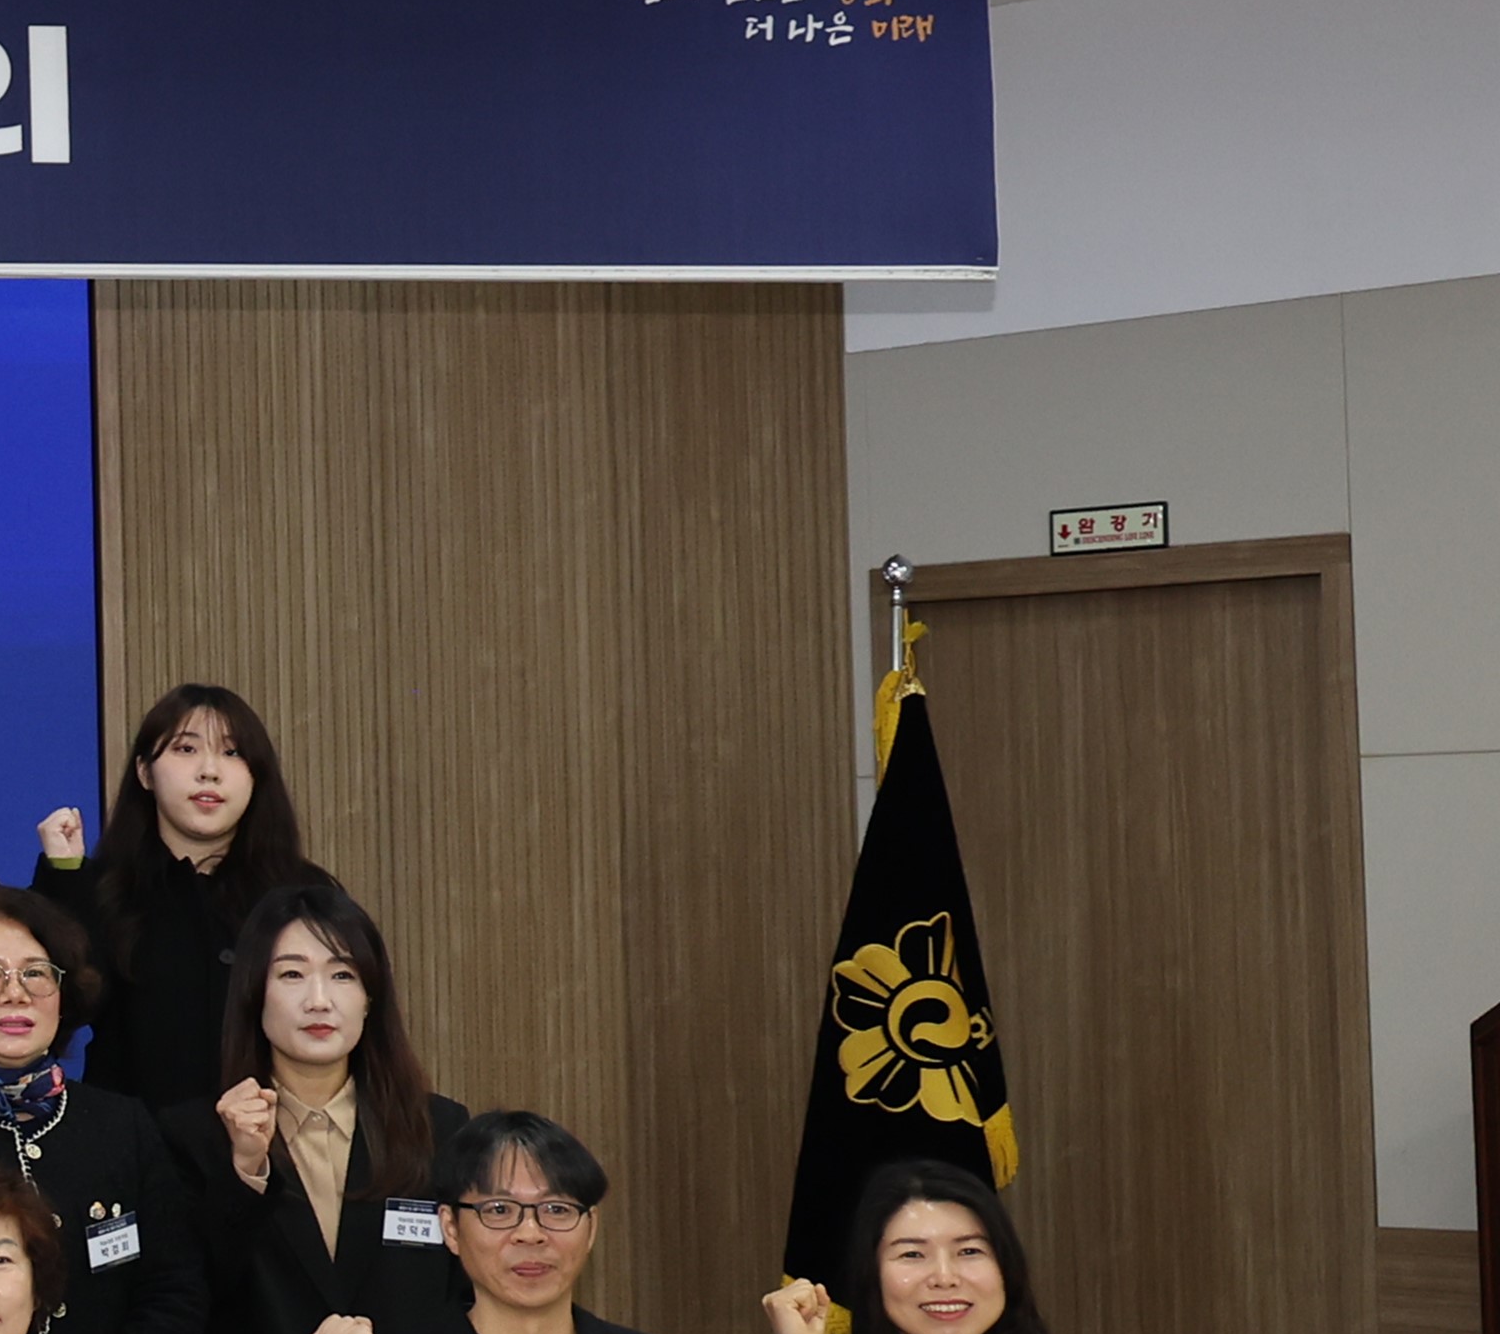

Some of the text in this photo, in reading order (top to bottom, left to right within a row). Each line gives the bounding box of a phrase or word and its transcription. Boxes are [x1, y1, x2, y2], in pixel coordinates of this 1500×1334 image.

[744, 11, 936, 47] 더 나은 미래
